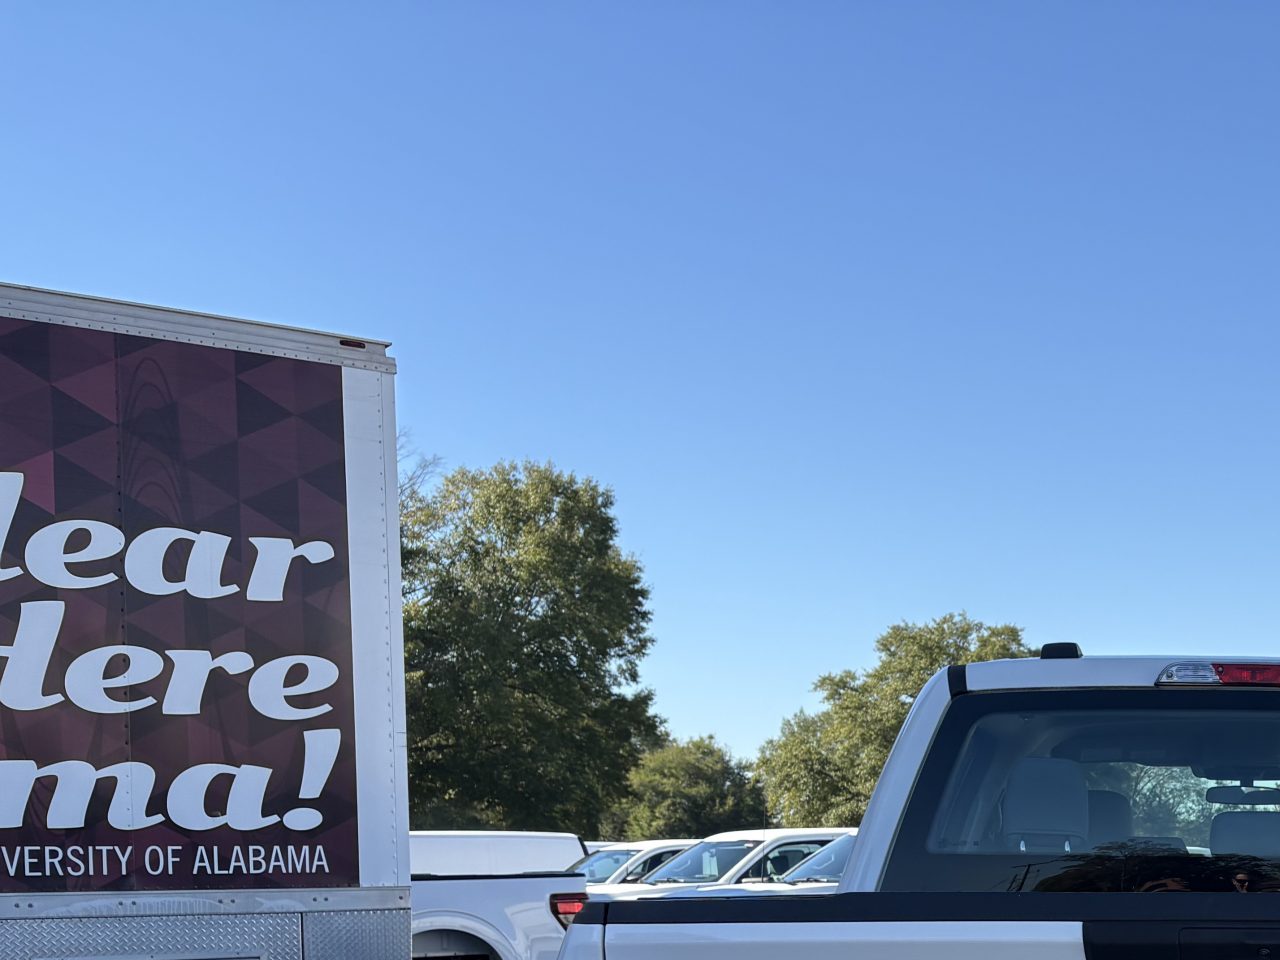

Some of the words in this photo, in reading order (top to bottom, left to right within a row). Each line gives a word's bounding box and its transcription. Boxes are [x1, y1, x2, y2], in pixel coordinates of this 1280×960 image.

[0, 845, 133, 877] VERSITY
[144, 845, 183, 875] OF
[192, 844, 330, 875] ALABAMA
